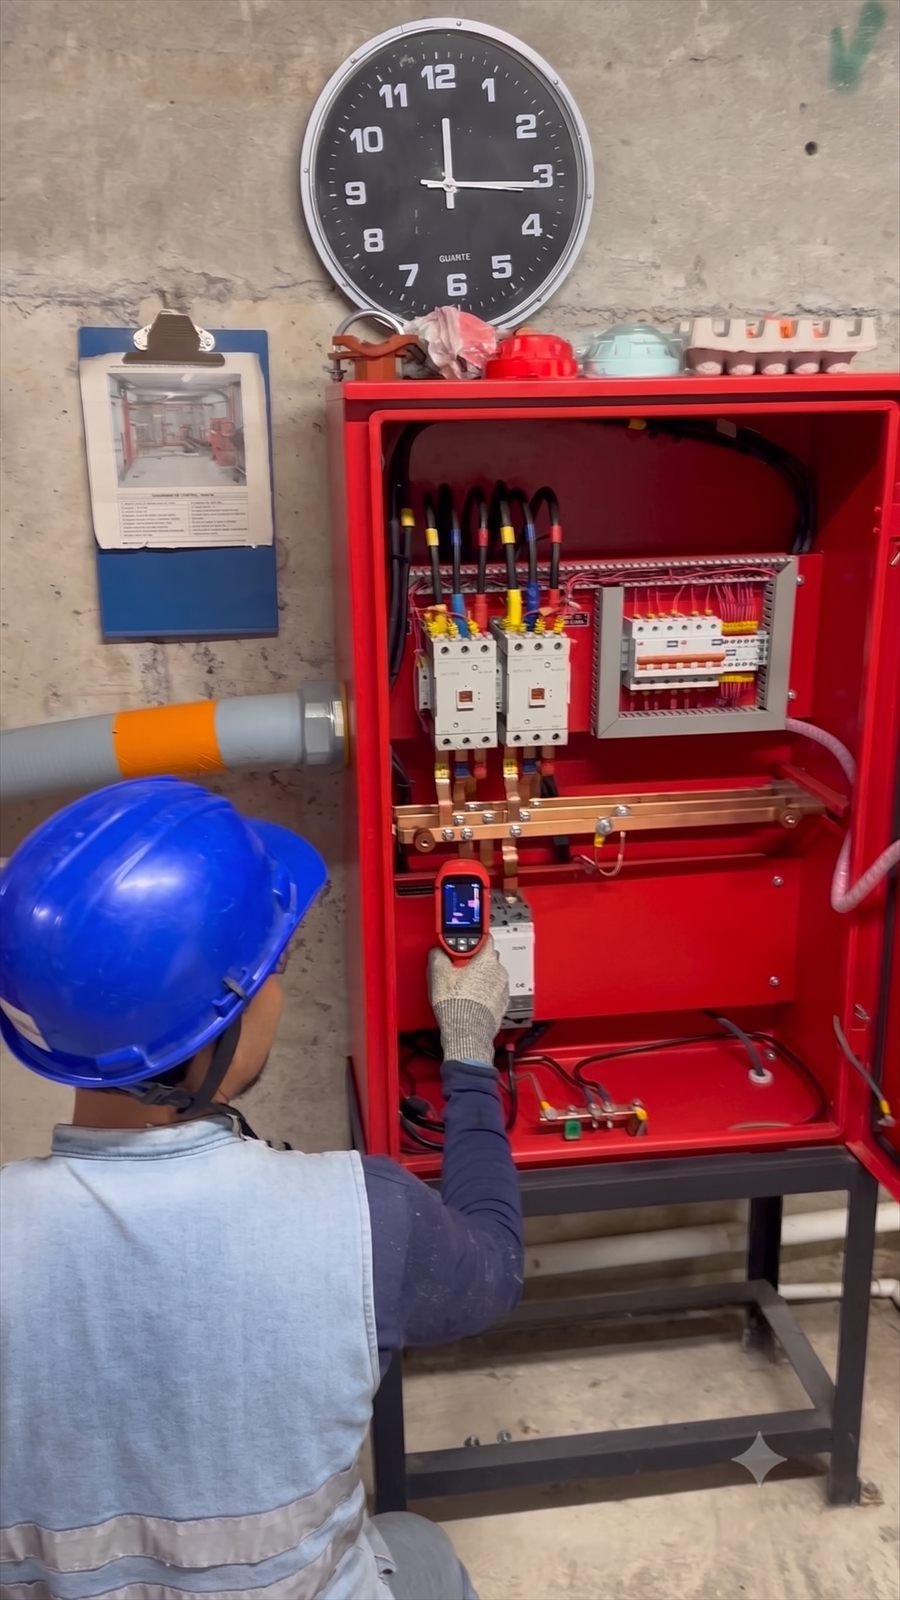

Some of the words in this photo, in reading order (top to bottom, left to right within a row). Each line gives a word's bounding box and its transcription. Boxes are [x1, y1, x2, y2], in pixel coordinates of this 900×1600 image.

[421, 64, 456, 90] 12
[379, 83, 408, 109] 11
[482, 78, 496, 103] 1
[516, 114, 537, 139] 2
[350, 126, 383, 153] 10
[533, 164, 553, 188] 3
[345, 181, 367, 205] 9
[521, 213, 542, 237] 4
[363, 228, 384, 253] 8
[399, 264, 418, 287] 7
[491, 255, 512, 279] 5
[446, 273, 467, 297] 6
